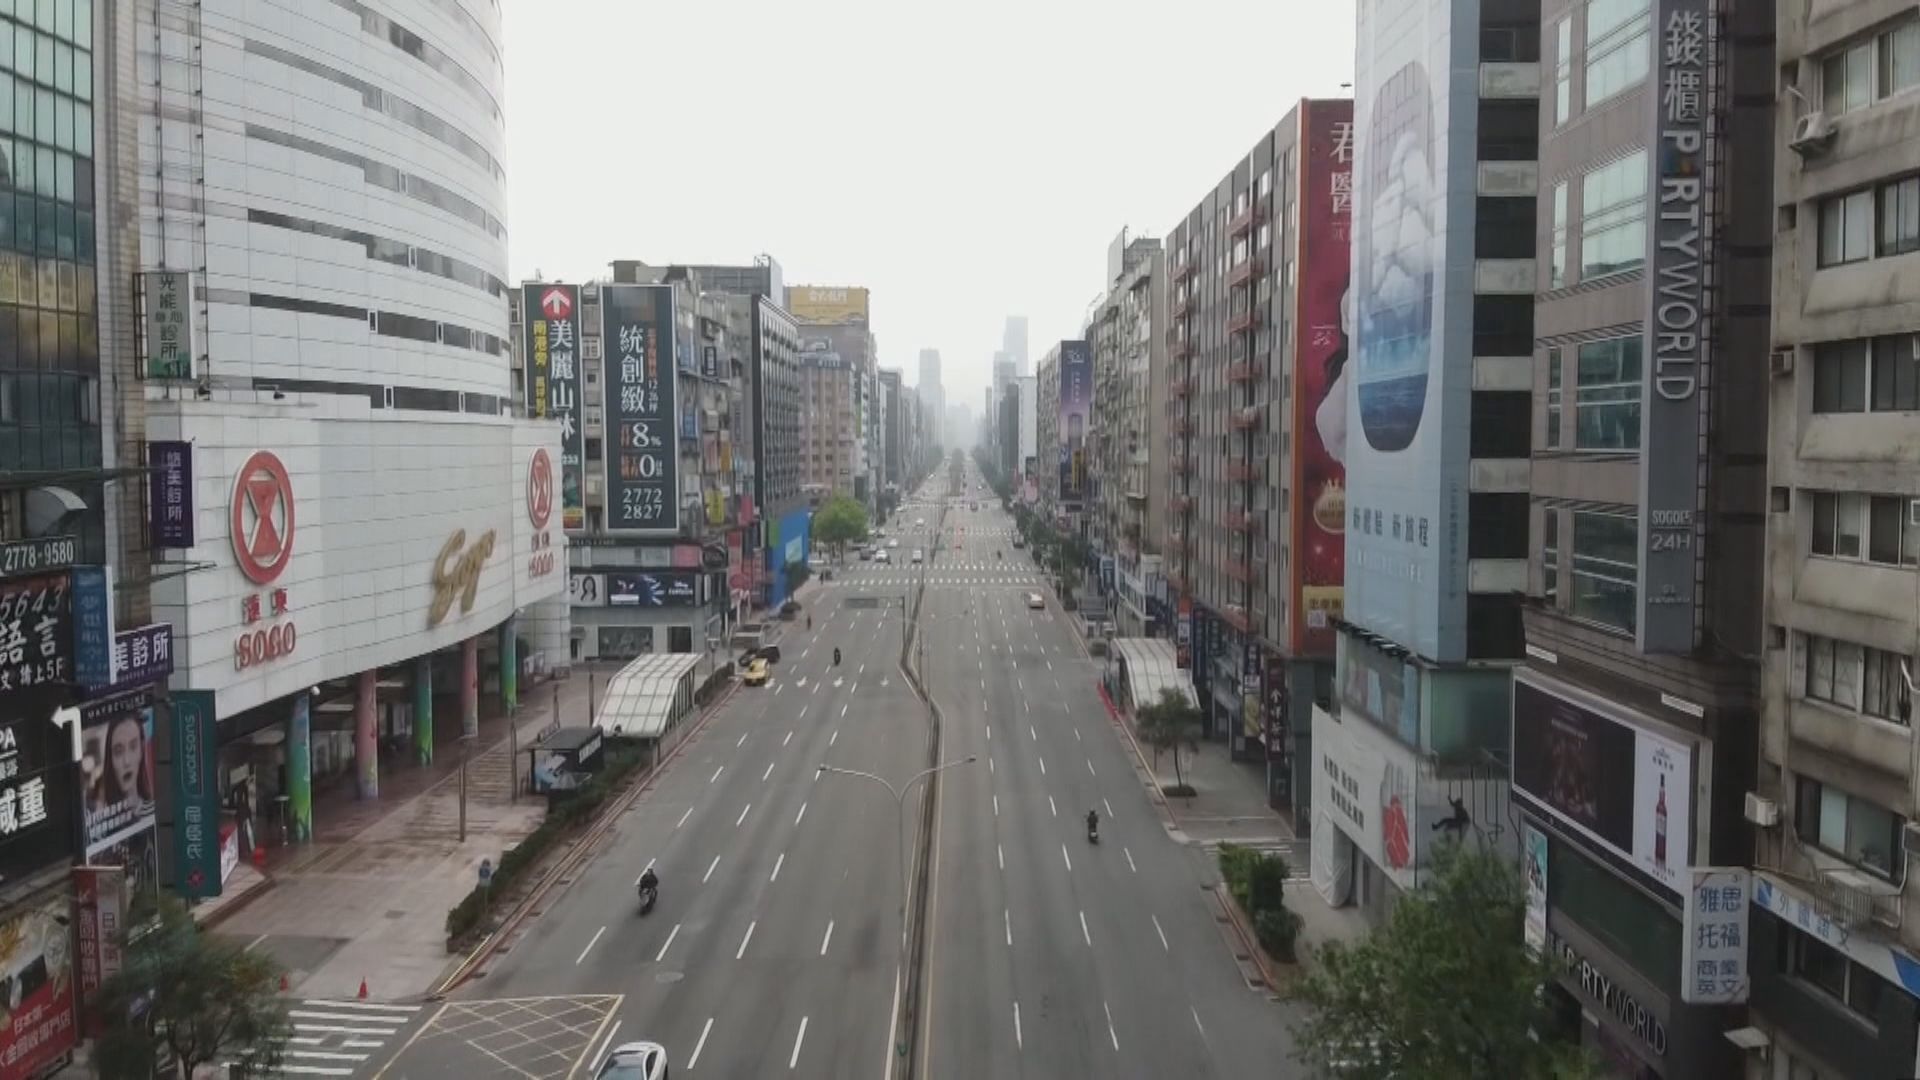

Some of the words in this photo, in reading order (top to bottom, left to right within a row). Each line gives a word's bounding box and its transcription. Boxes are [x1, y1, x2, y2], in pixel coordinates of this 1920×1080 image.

[1664, 10, 1702, 122] 錢櫃
[622, 488, 663, 504] 2772
[623, 504, 663, 520] 2827
[1651, 533, 1691, 552] 24H
[5, 541, 74, 571] 2778-9580
[234, 621, 296, 672] SOGO
[180, 714, 197, 783] watsons
[1699, 887, 1742, 913] 雅思
[1697, 923, 1741, 949] 托福
[1696, 959, 1739, 976] 商業
[1696, 979, 1739, 996] 英文
